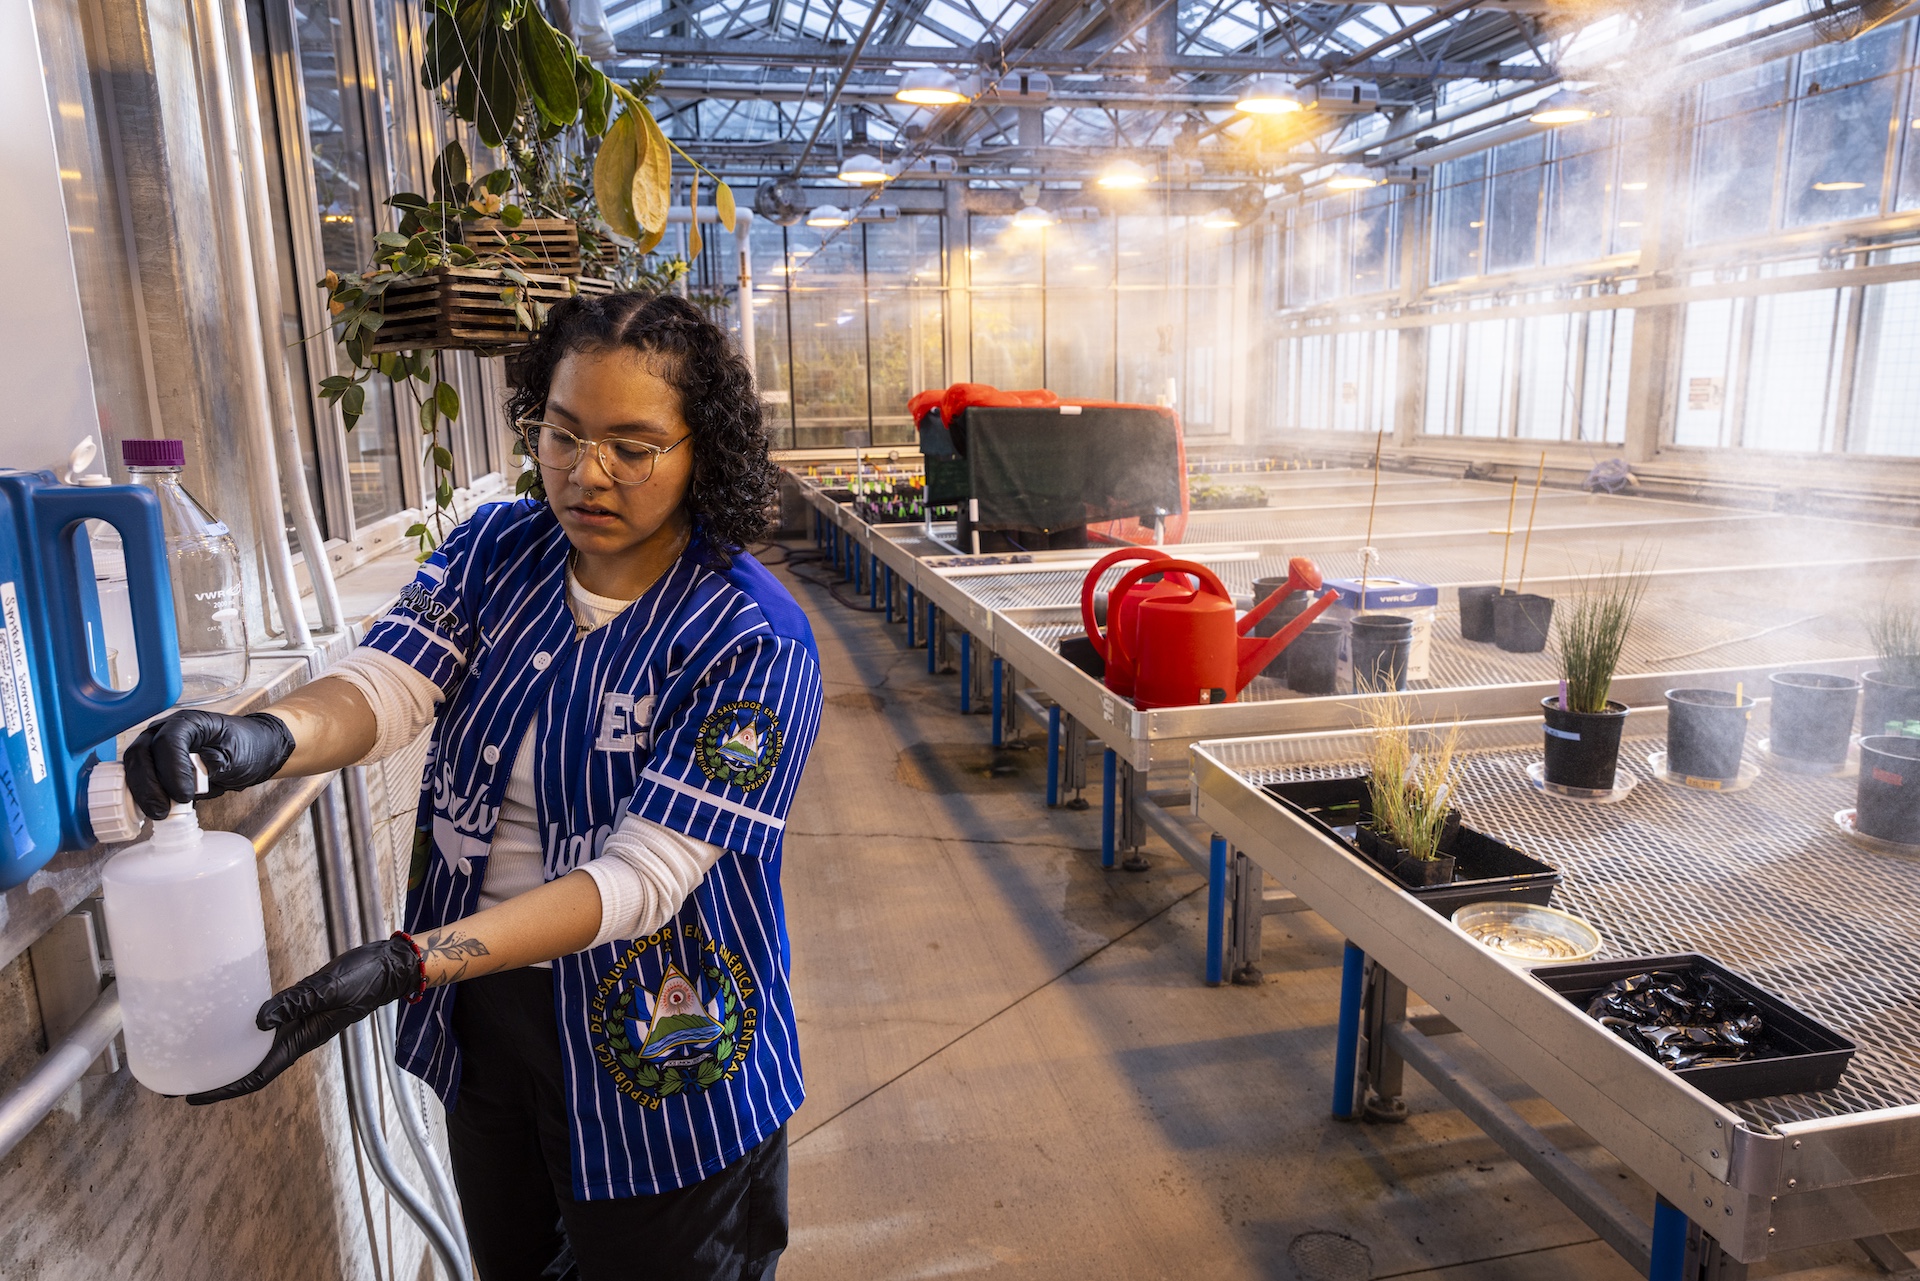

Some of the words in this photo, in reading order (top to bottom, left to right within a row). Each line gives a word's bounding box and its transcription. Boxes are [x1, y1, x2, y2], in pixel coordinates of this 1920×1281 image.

[194, 590, 225, 601] VWR
[1379, 595, 1400, 603] VWR
[5, 596, 23, 667] Synthetic
[717, 701, 762, 716] SALVADOR
[742, 770, 771, 793] CENTRAL
[597, 928, 672, 995] SALVADOR
[719, 943, 755, 1000] AMÉRICA
[591, 1014, 603, 1034] DE
[592, 992, 606, 1011] EL
[723, 1008, 757, 1081] CENTRAL
[595, 1043, 662, 1110] REPÚBLICA
